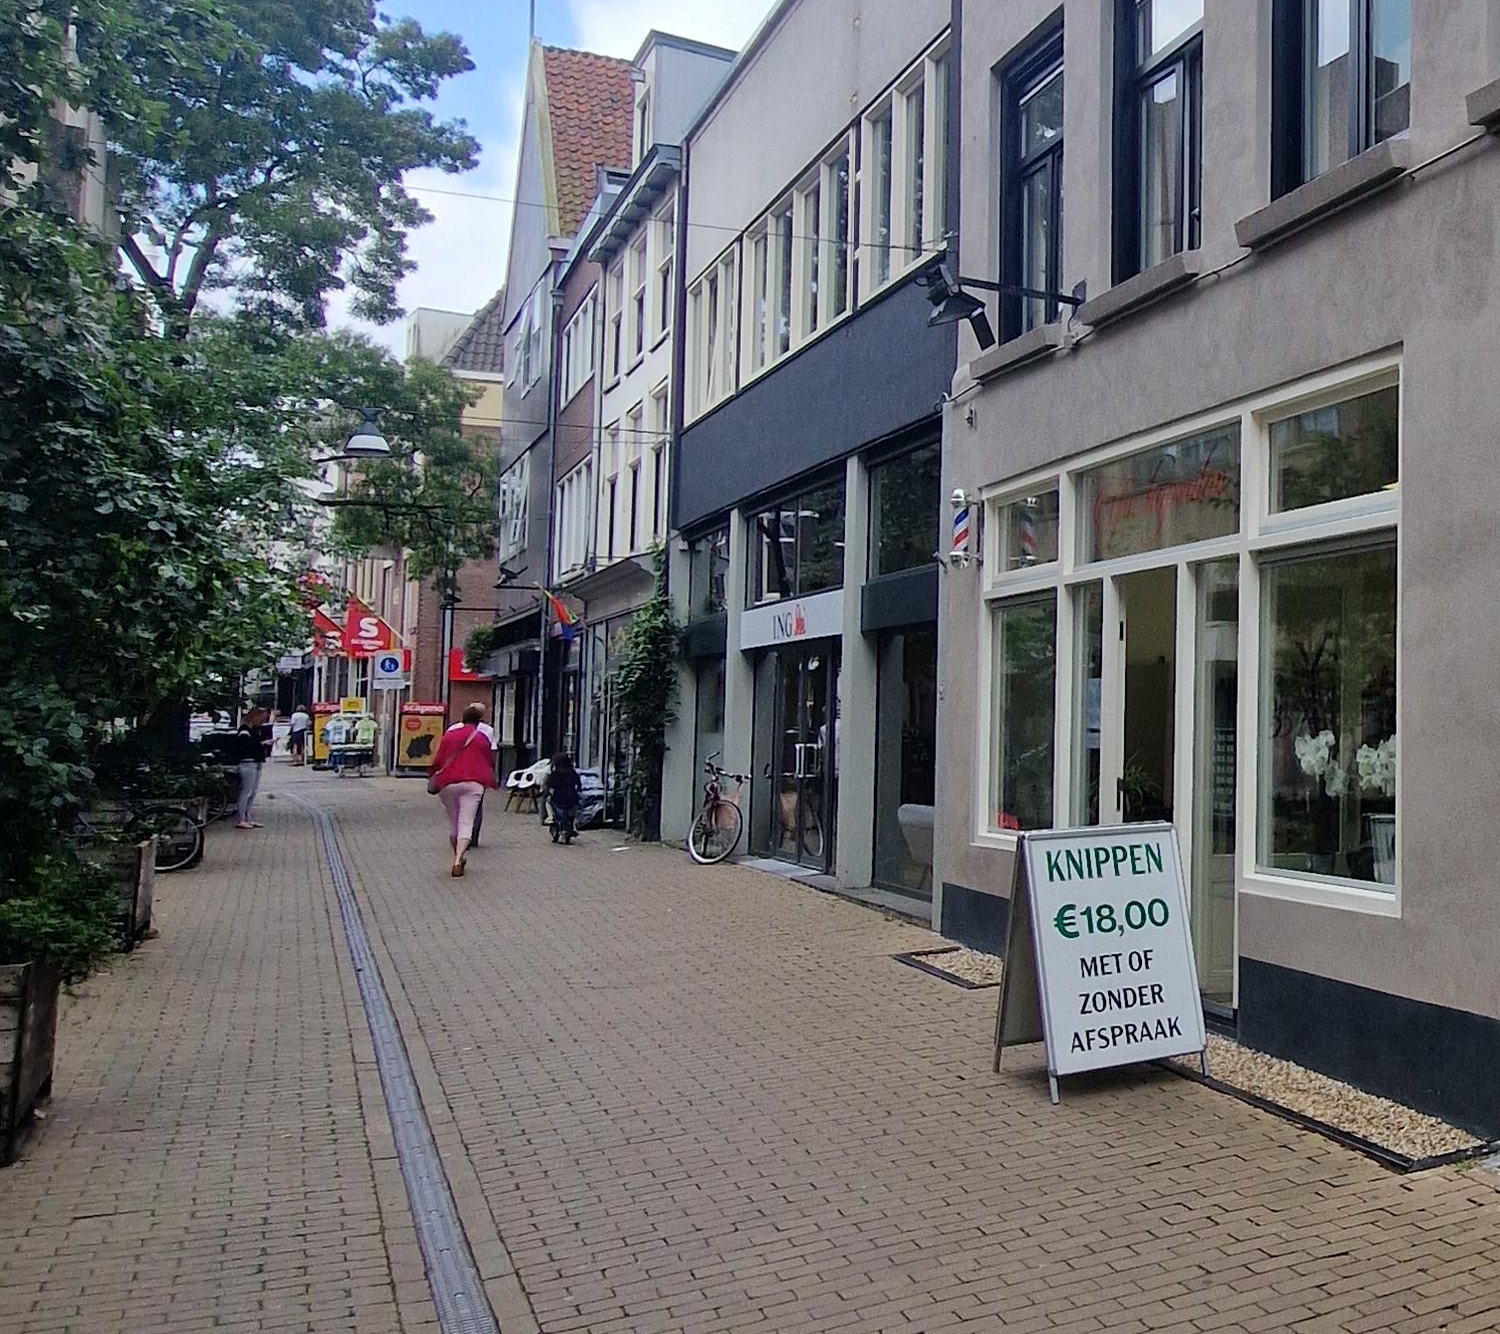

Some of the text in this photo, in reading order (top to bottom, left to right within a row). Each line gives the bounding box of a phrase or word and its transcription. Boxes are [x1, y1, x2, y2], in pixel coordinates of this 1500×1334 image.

[772, 611, 793, 640] ING
[1046, 843, 1164, 882] KNIPPEN
[1053, 898, 1169, 939] €18,00
[1080, 949, 1154, 978] MET OF
[1079, 983, 1165, 1015] ZONDER
[1070, 1017, 1183, 1054] AFSPRAAK
